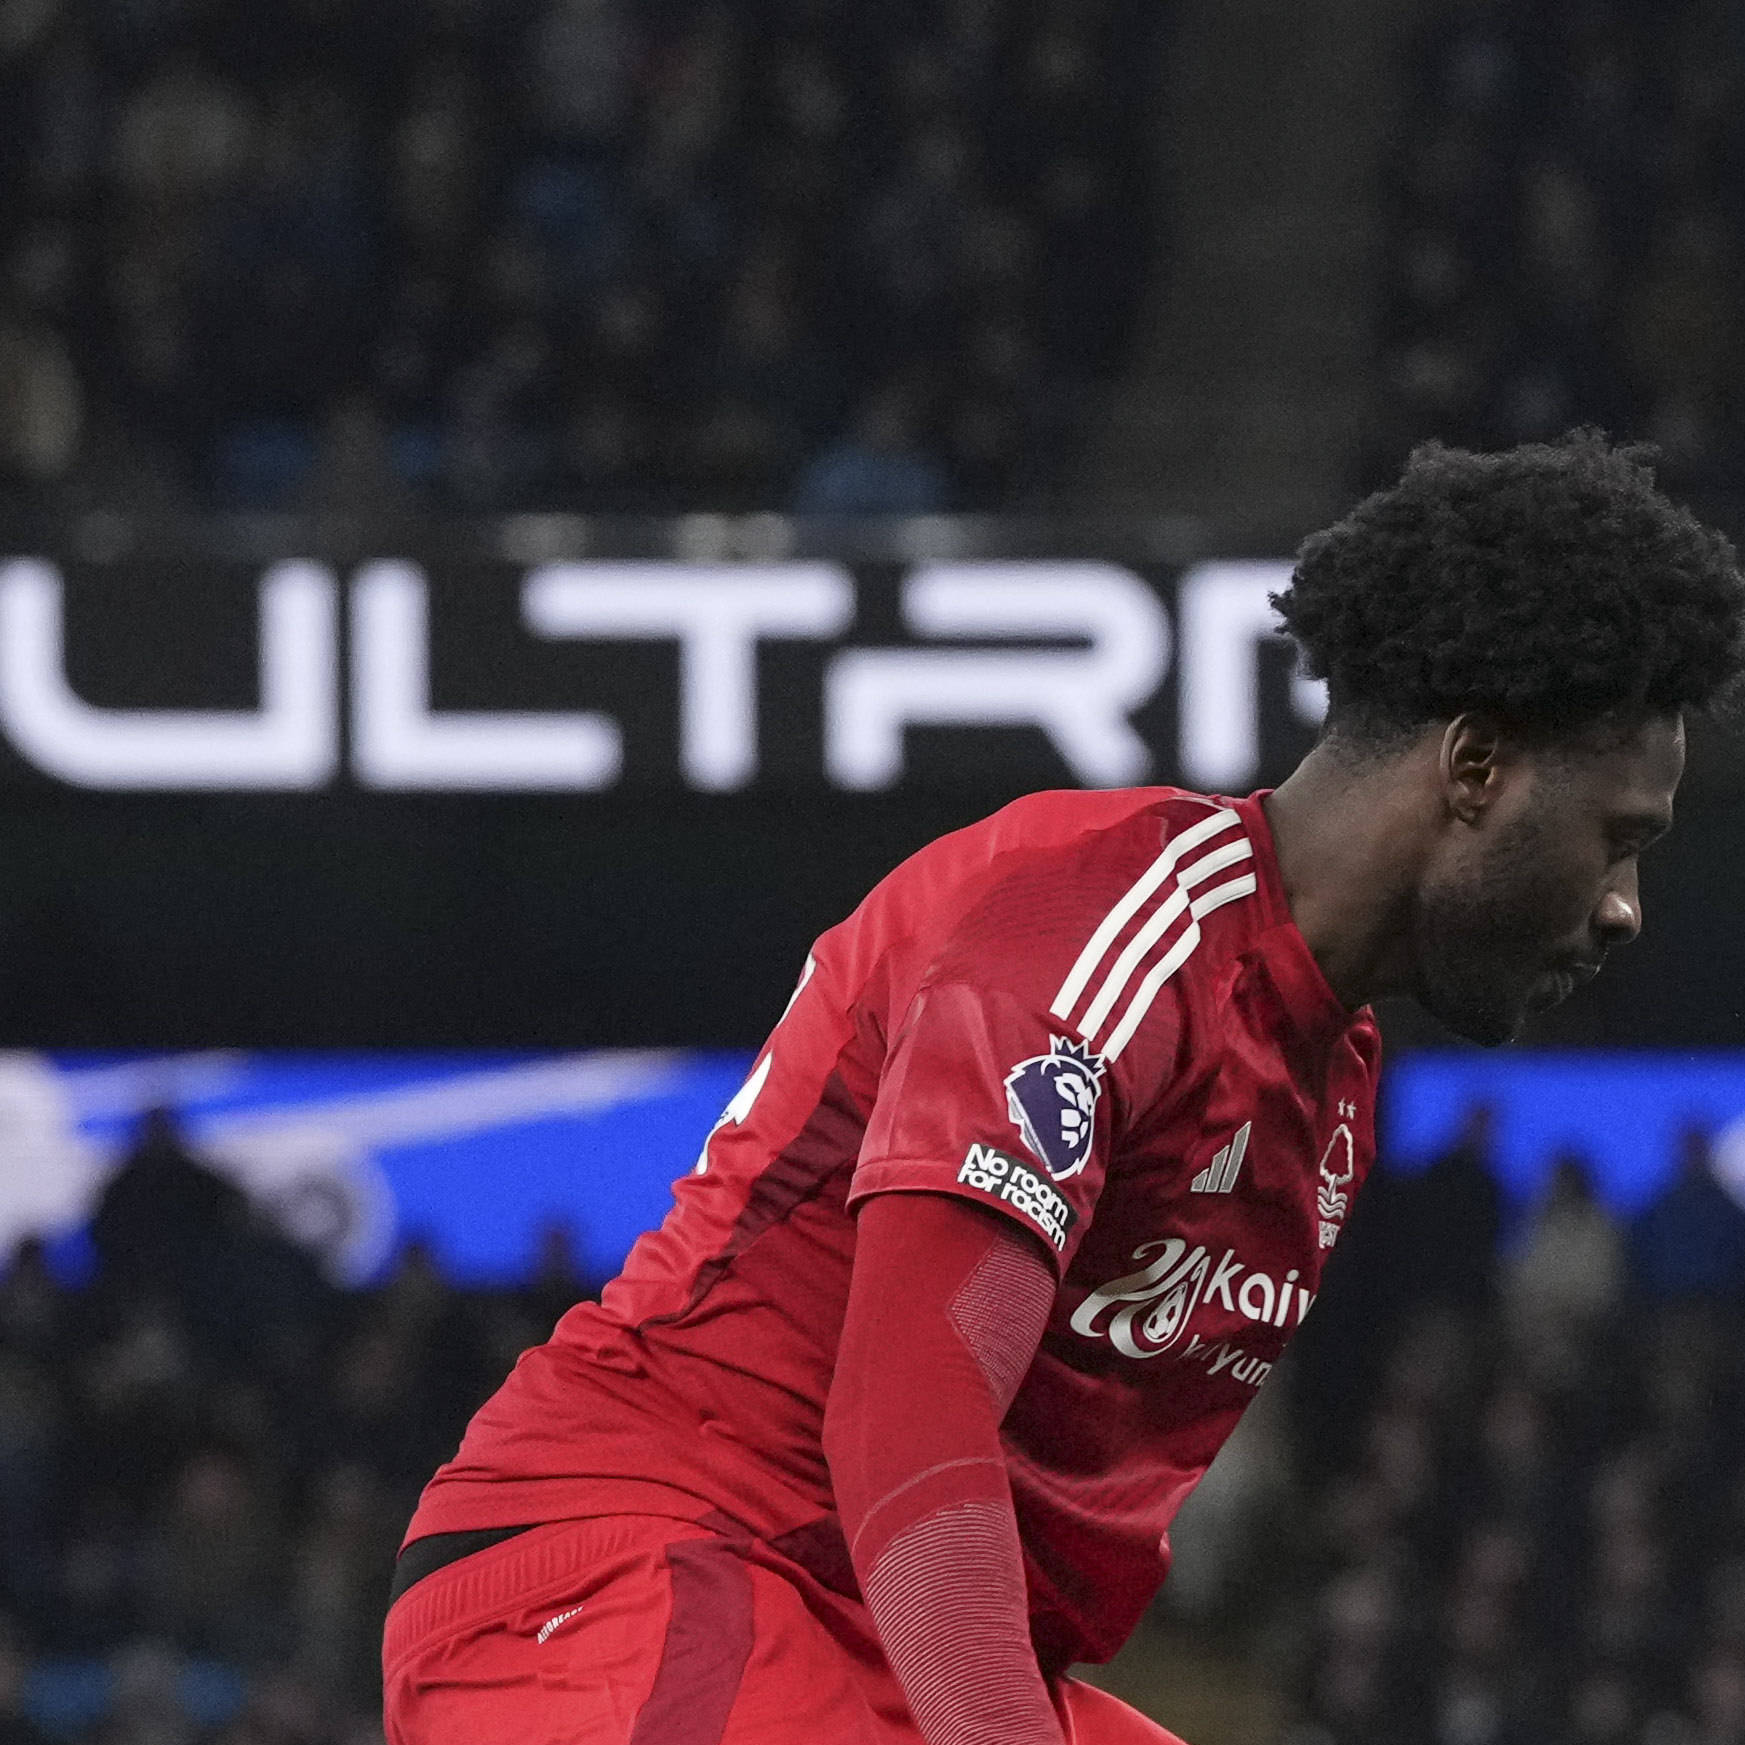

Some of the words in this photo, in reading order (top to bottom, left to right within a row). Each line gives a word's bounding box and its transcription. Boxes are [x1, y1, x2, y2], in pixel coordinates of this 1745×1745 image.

[957, 1162, 1001, 1193] for
[1001, 1181, 1067, 1252] racism
[966, 1143, 1008, 1176] No
[1010, 1165, 1069, 1226] room
